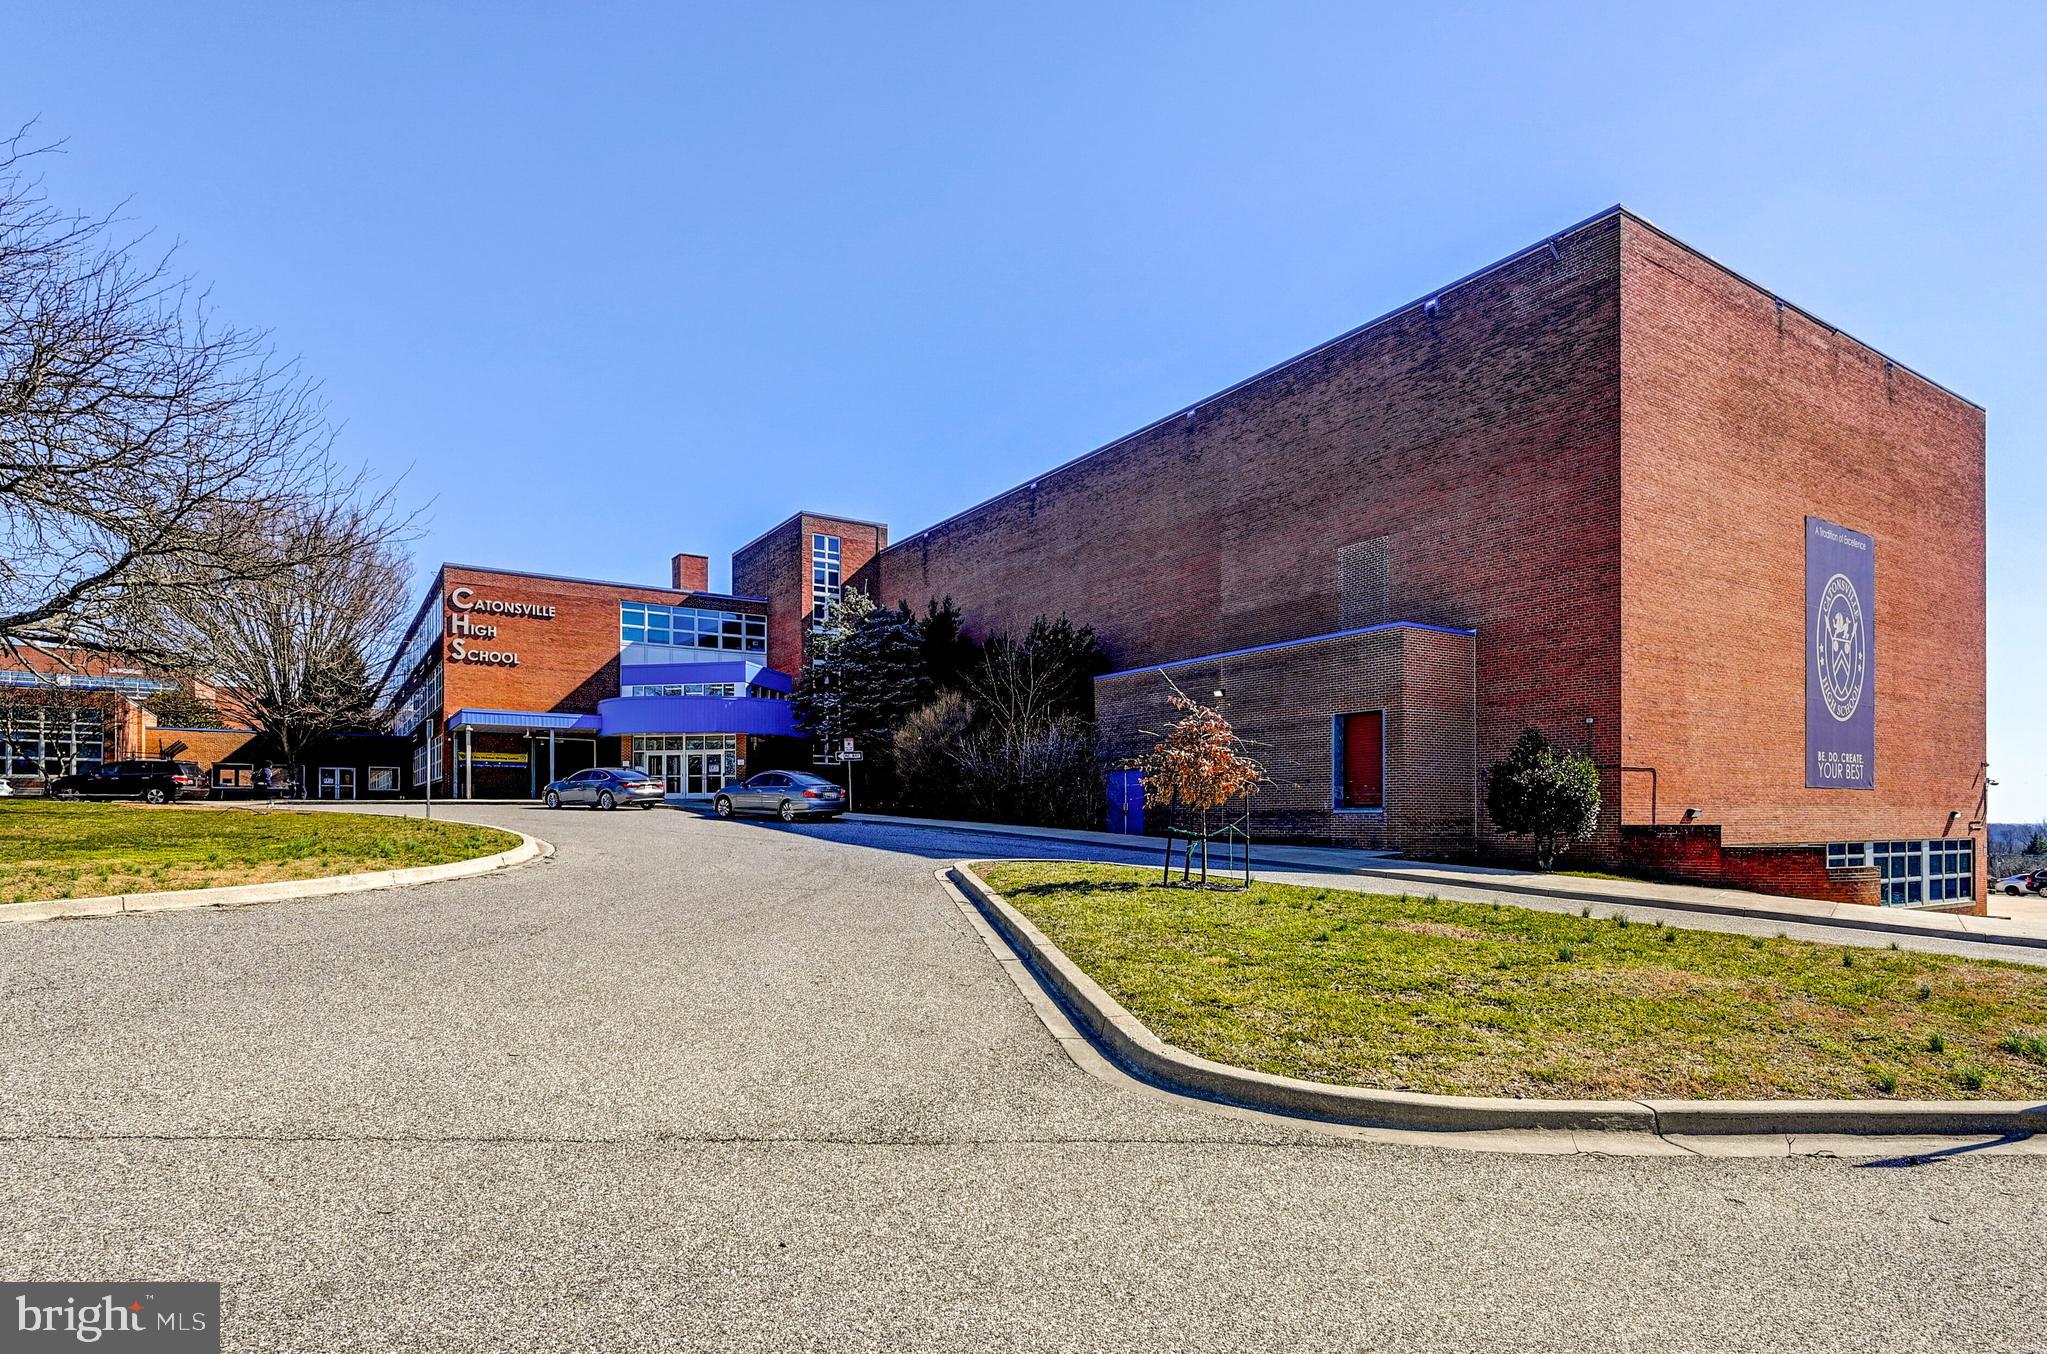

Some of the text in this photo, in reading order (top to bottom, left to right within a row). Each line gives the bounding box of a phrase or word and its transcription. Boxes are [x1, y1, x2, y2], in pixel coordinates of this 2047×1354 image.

[1819, 527, 1839, 541] Tradition
[1843, 535, 1867, 551] Excellence
[451, 587, 556, 617] CATONSVILLE
[1823, 579, 1859, 620] CATONSVILLE
[451, 613, 497, 637] HIGH
[451, 638, 521, 664] SCHOOL
[1822, 676, 1860, 716] HIGH SCHOOL
[1817, 751, 1828, 762] BE.
[1828, 752, 1840, 762] DO.
[1818, 762, 1864, 780] YOUR BEST
